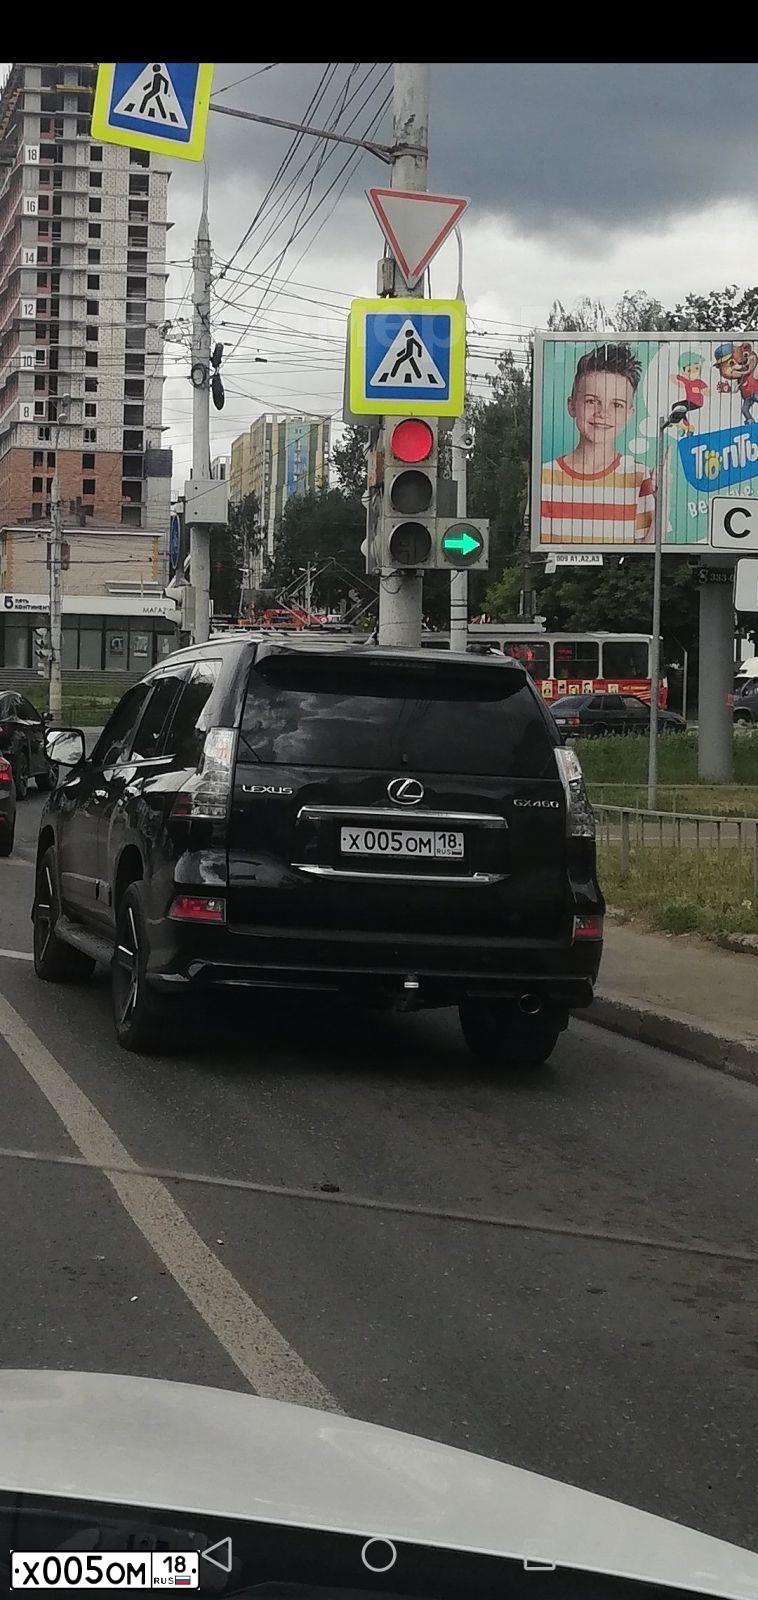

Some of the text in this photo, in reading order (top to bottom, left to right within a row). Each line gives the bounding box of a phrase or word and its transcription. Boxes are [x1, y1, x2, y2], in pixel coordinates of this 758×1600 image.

[28, 149, 37, 161] 18
[26, 201, 36, 213] 16
[25, 252, 35, 264] 14
[24, 303, 34, 315] 12
[23, 356, 32, 367] 10
[24, 406, 30, 417] 8
[242, 784, 293, 795] LEXUS
[513, 799, 560, 808] GX460
[438, 834, 458, 848] 18
[436, 848, 451, 856] RUS
